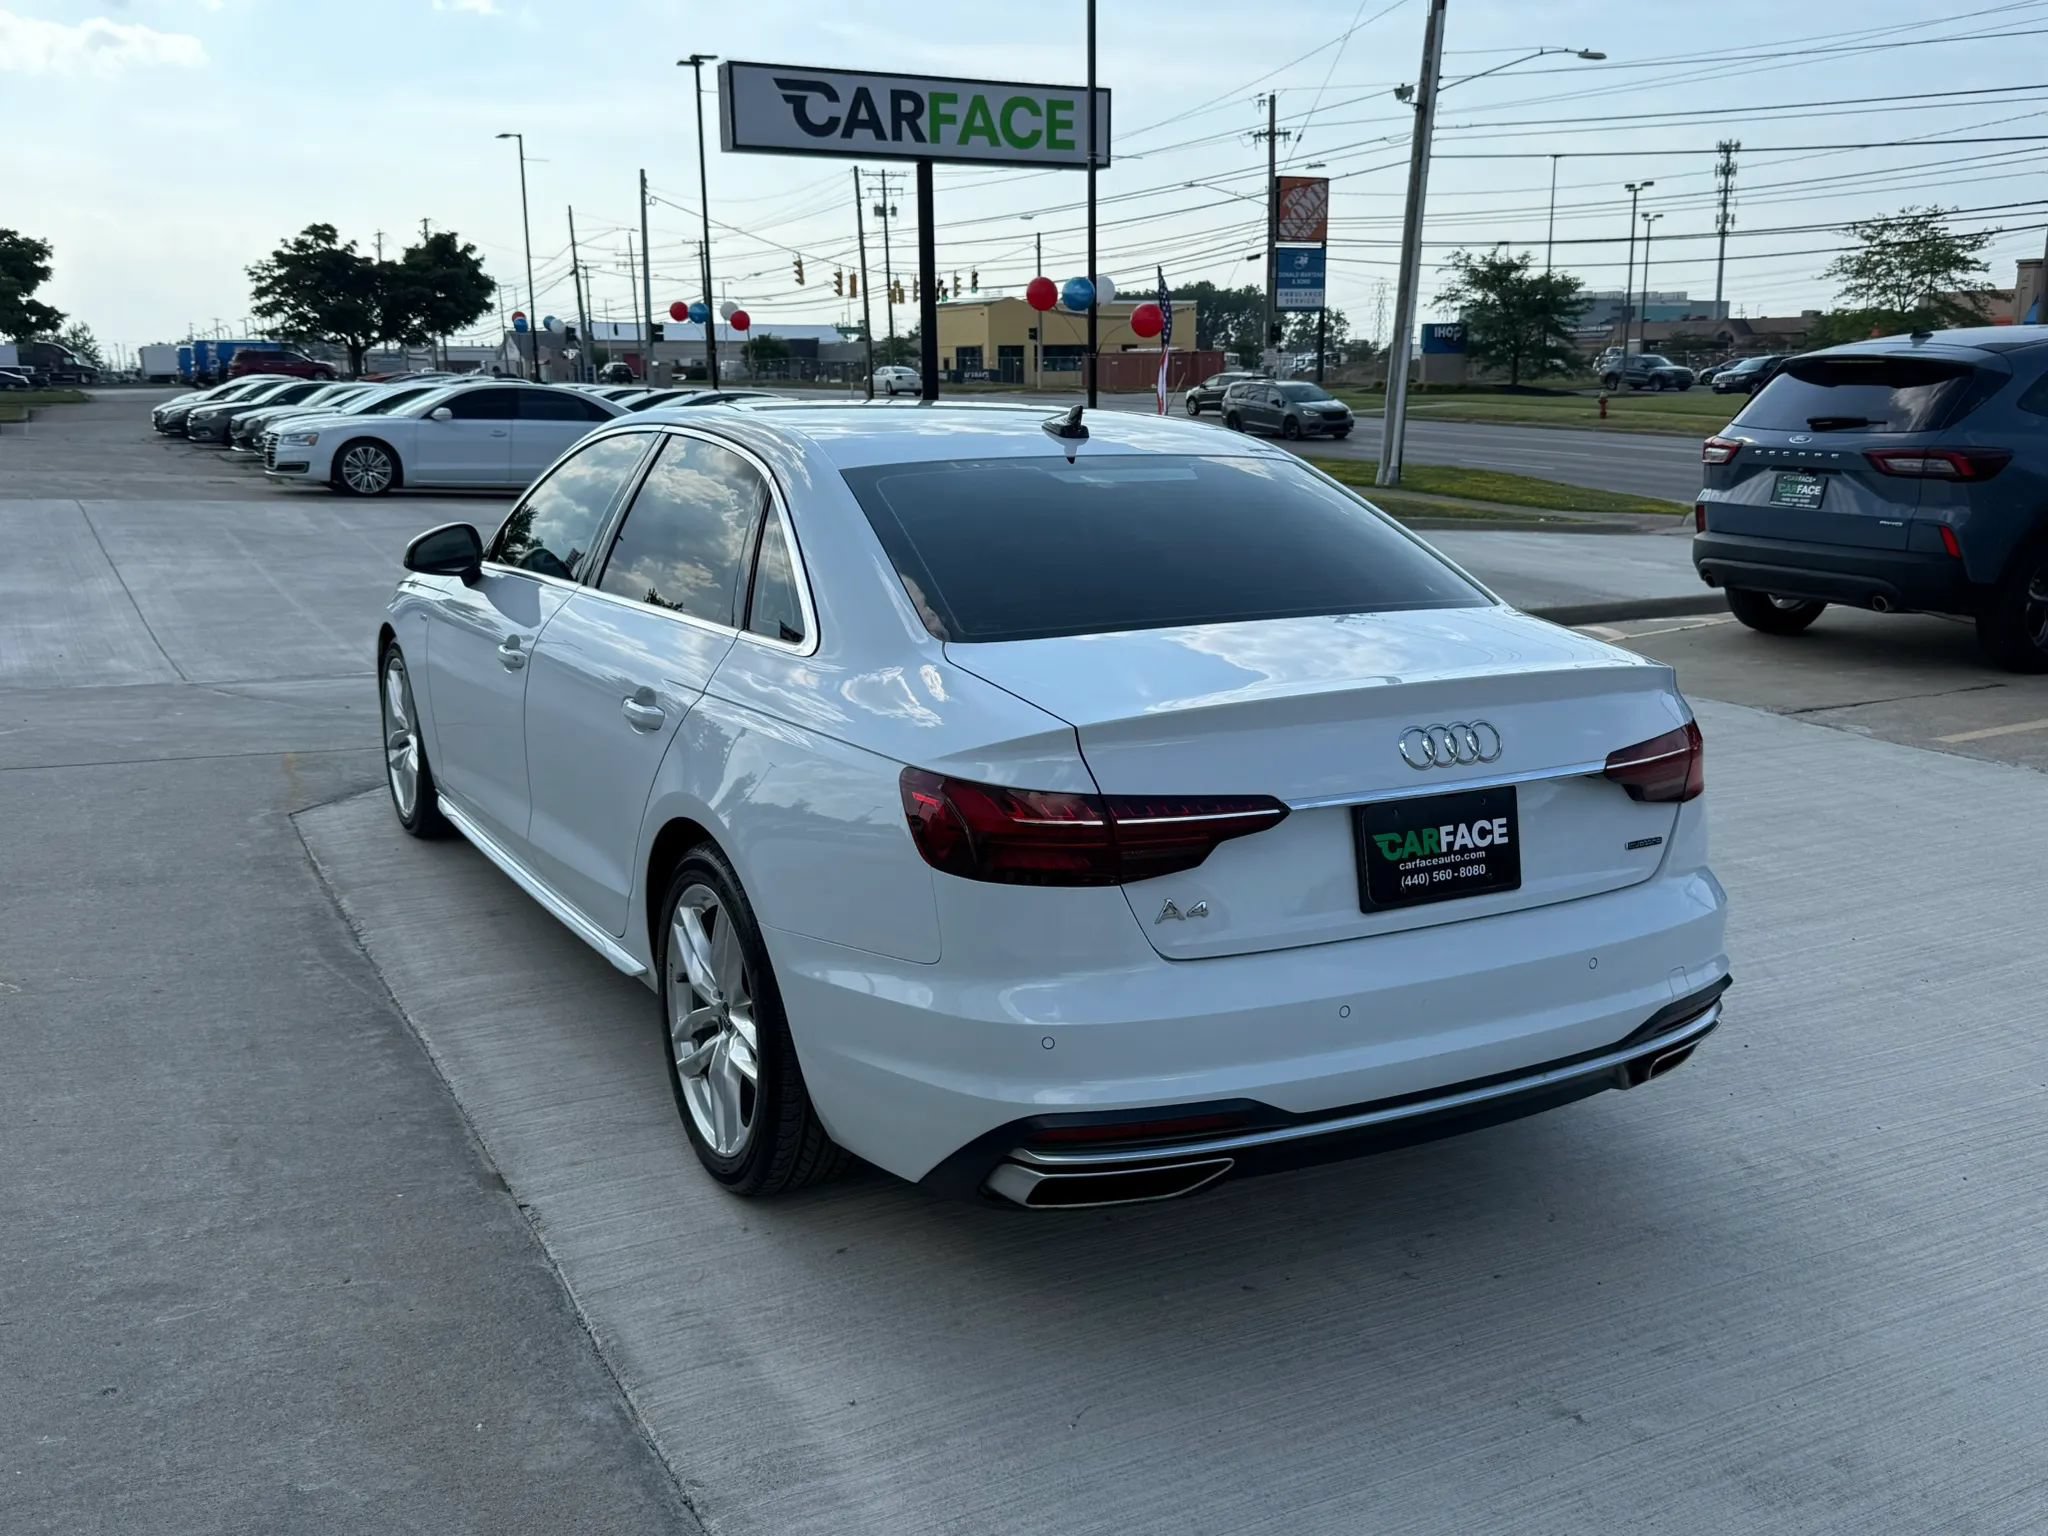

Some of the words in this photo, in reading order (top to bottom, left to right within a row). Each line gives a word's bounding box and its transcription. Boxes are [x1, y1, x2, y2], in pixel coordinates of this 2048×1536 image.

[772, 77, 1076, 151] CARFACE
[1777, 483, 1821, 495] CARFACE
[1372, 817, 1508, 861] CARFACE
[1399, 851, 1486, 871] carfaceauto.com
[1401, 872, 1430, 888] (440)
[1154, 898, 1208, 925] A4
